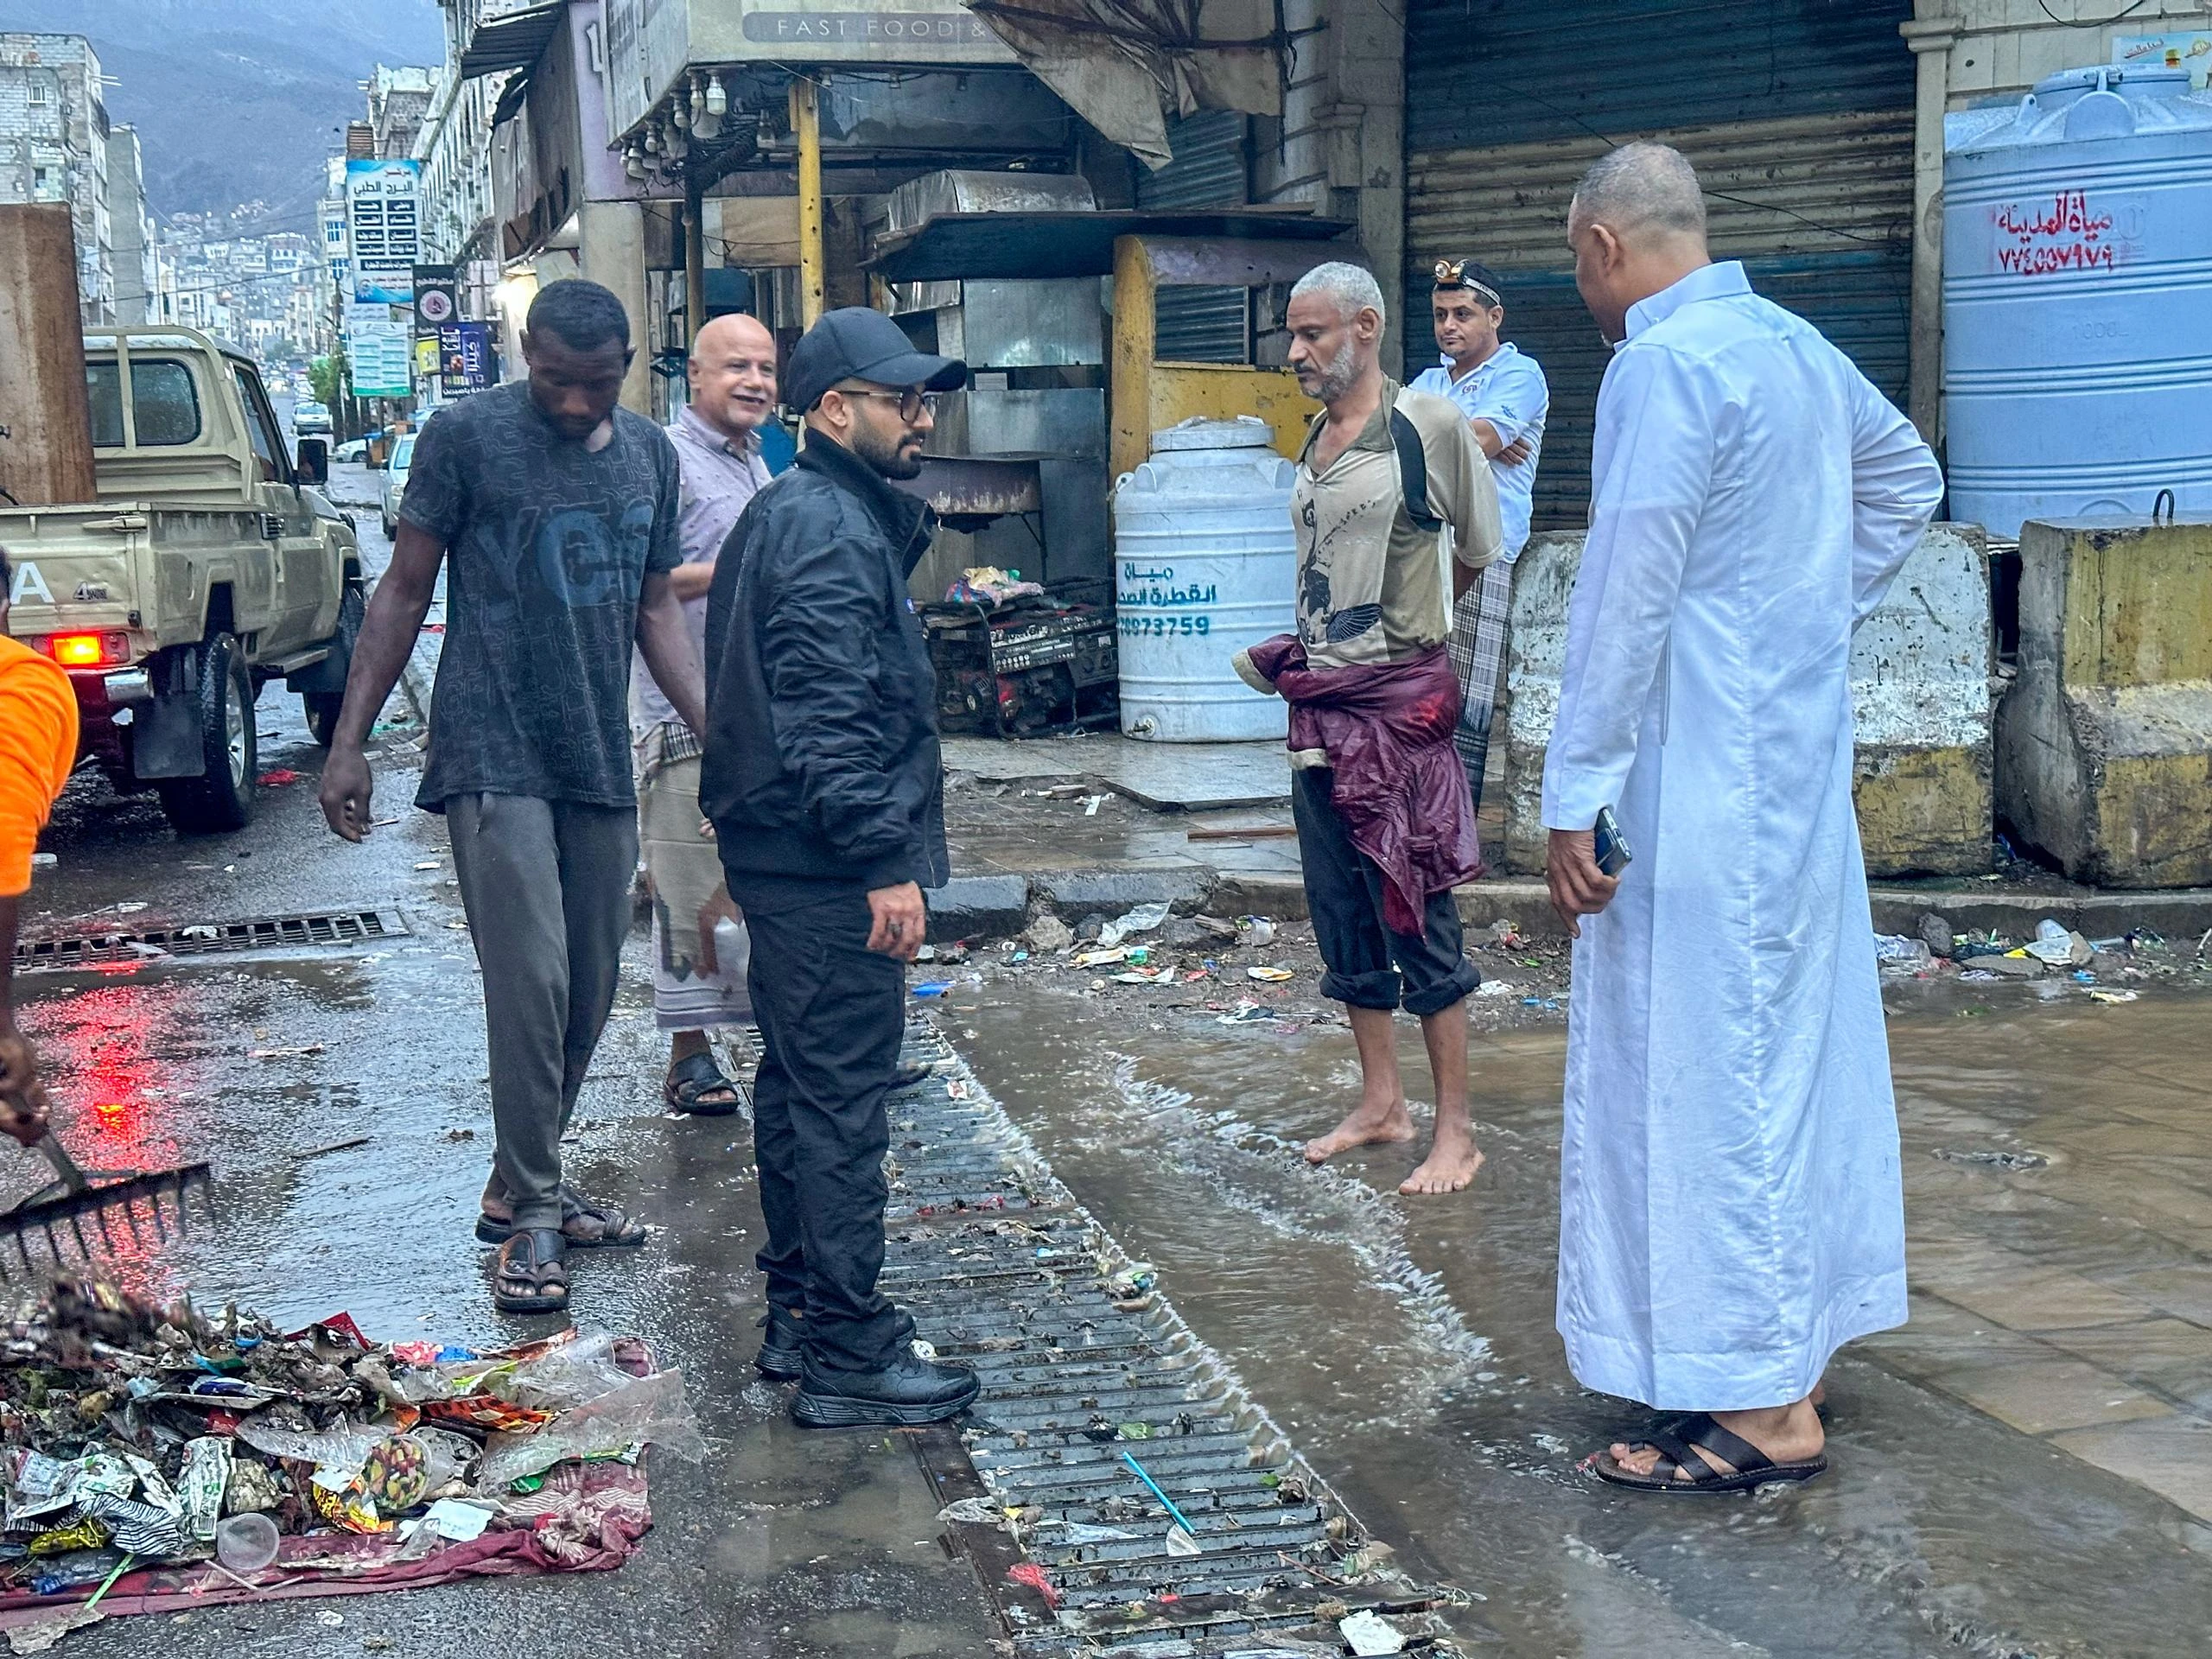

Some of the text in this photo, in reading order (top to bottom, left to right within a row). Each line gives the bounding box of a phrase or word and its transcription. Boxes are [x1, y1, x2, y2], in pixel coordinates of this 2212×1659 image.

[778, 19, 847, 36] FAST
[867, 19, 953, 37] FOOD
[353, 181, 414, 198] البرج الطبي
[1150, 584, 1217, 607] القطرة
